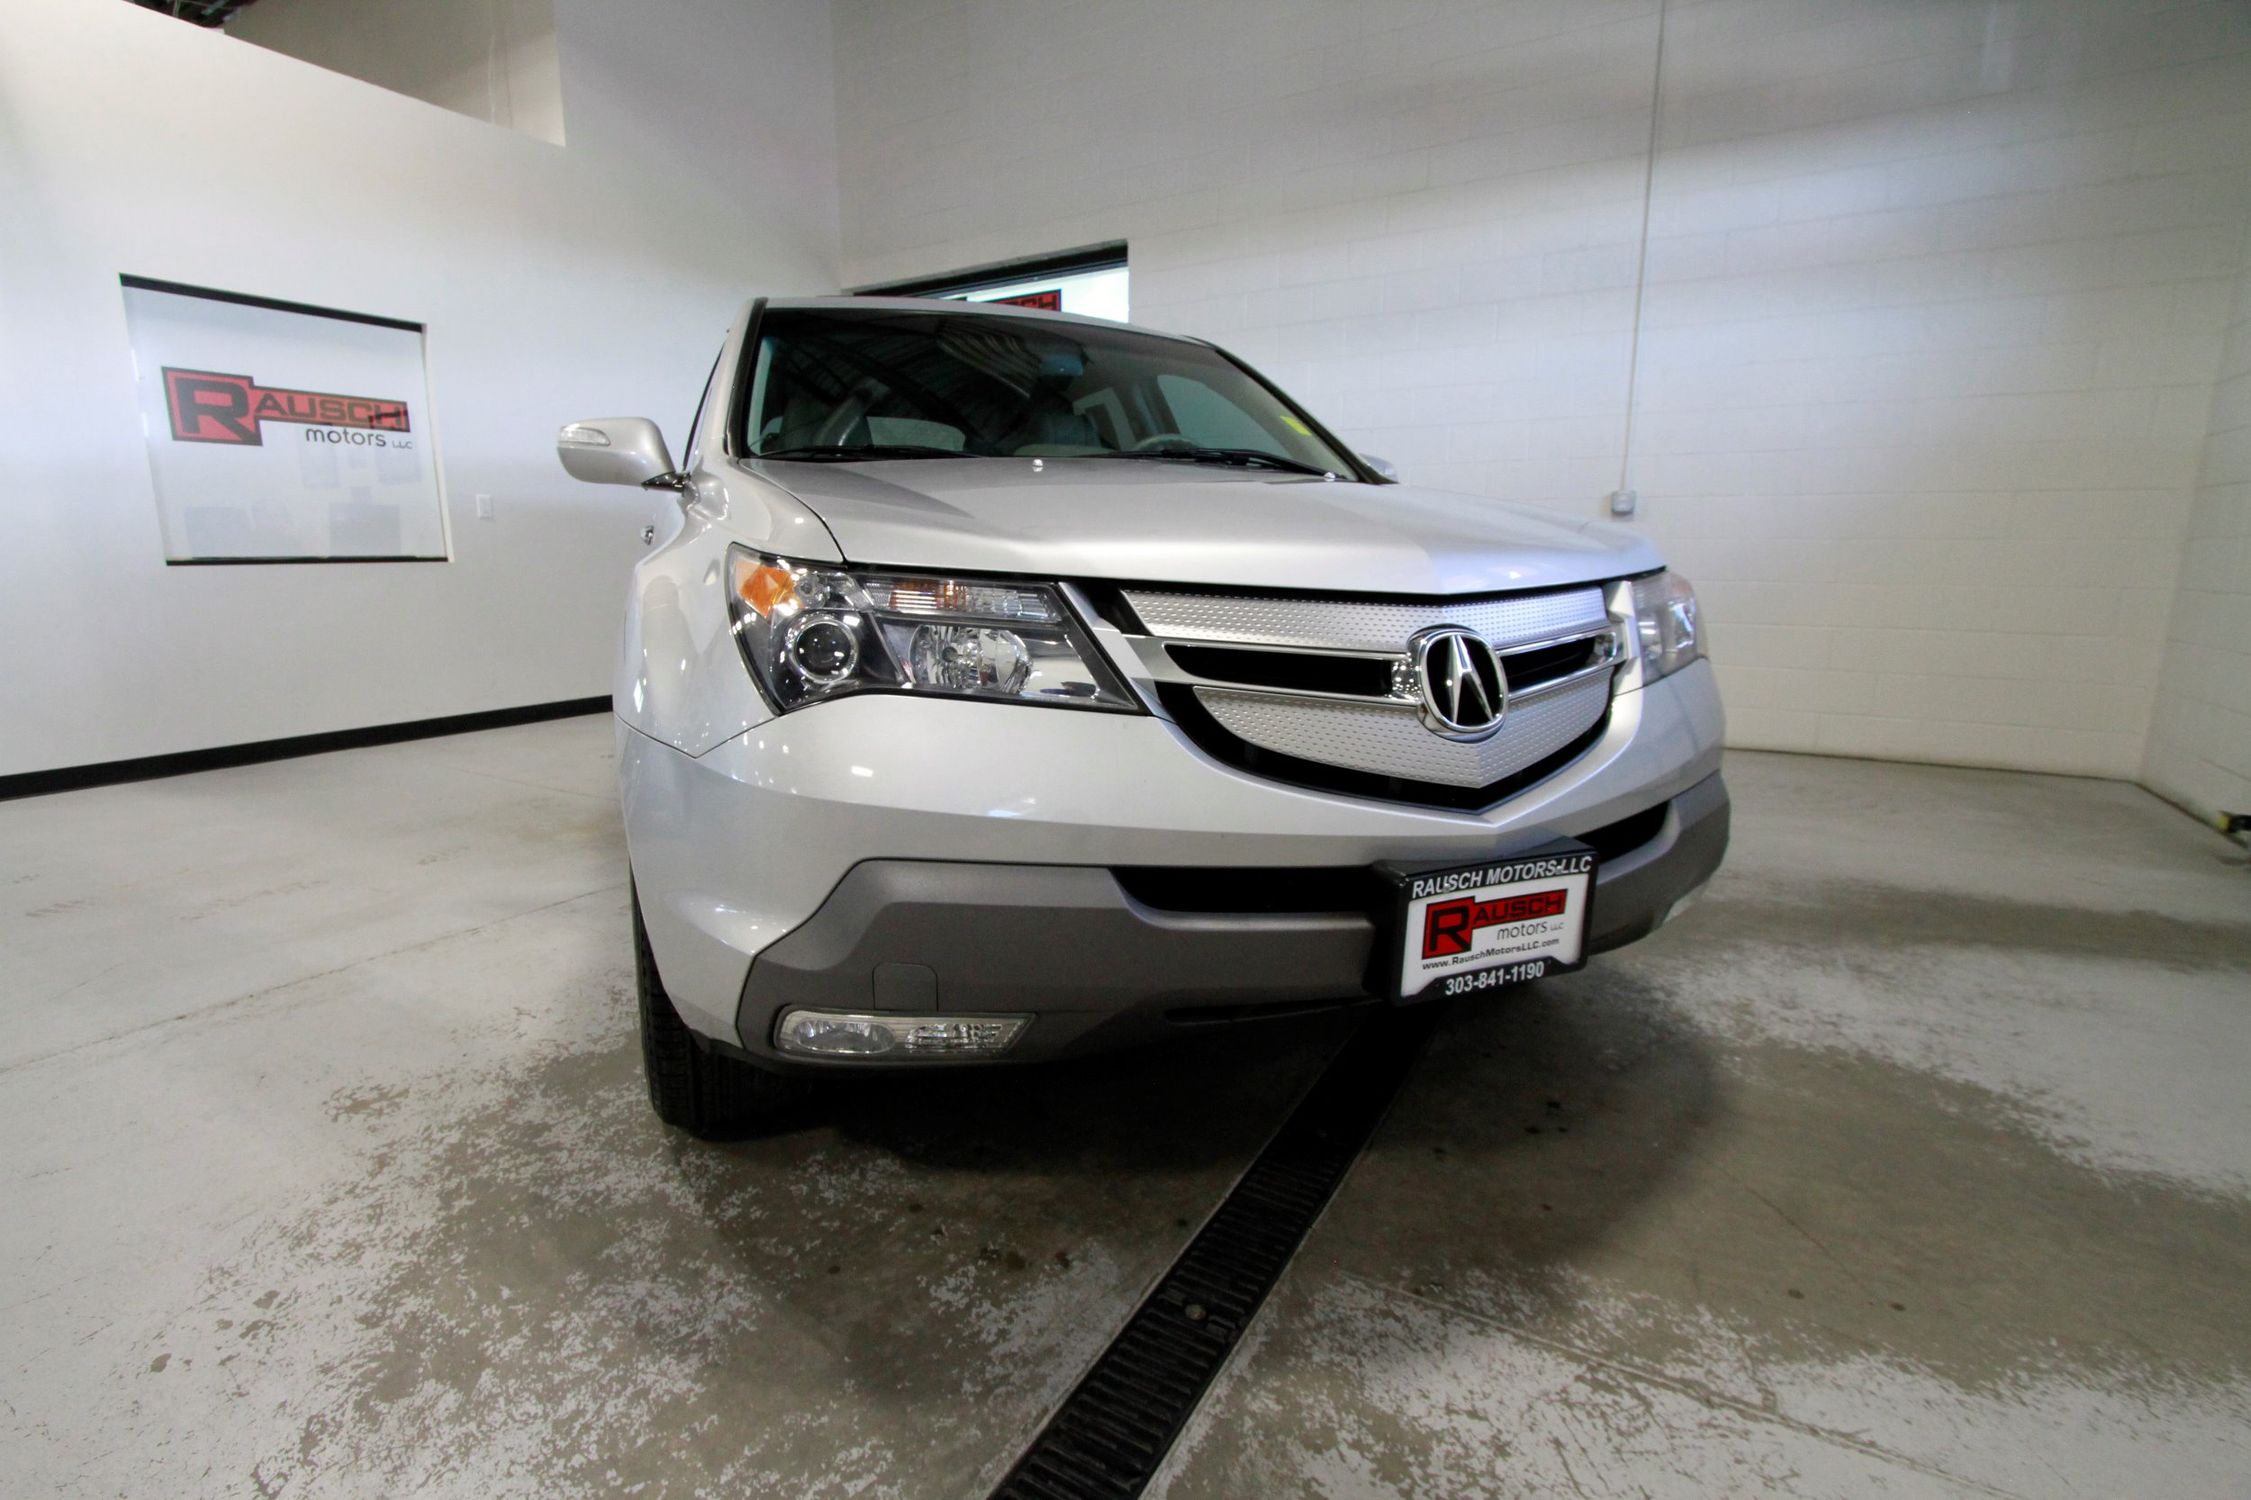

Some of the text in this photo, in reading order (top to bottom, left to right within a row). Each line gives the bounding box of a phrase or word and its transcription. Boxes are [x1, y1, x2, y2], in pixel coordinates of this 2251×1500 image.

[175, 377, 402, 441] RAUSCH
[306, 428, 386, 447] motors
[1412, 856, 1592, 899] RAUSCH MOTORS LLC
[1430, 896, 1562, 952] RAUSCH
[1496, 921, 1548, 940] motors
[1445, 961, 1545, 995] 303-841-1190
